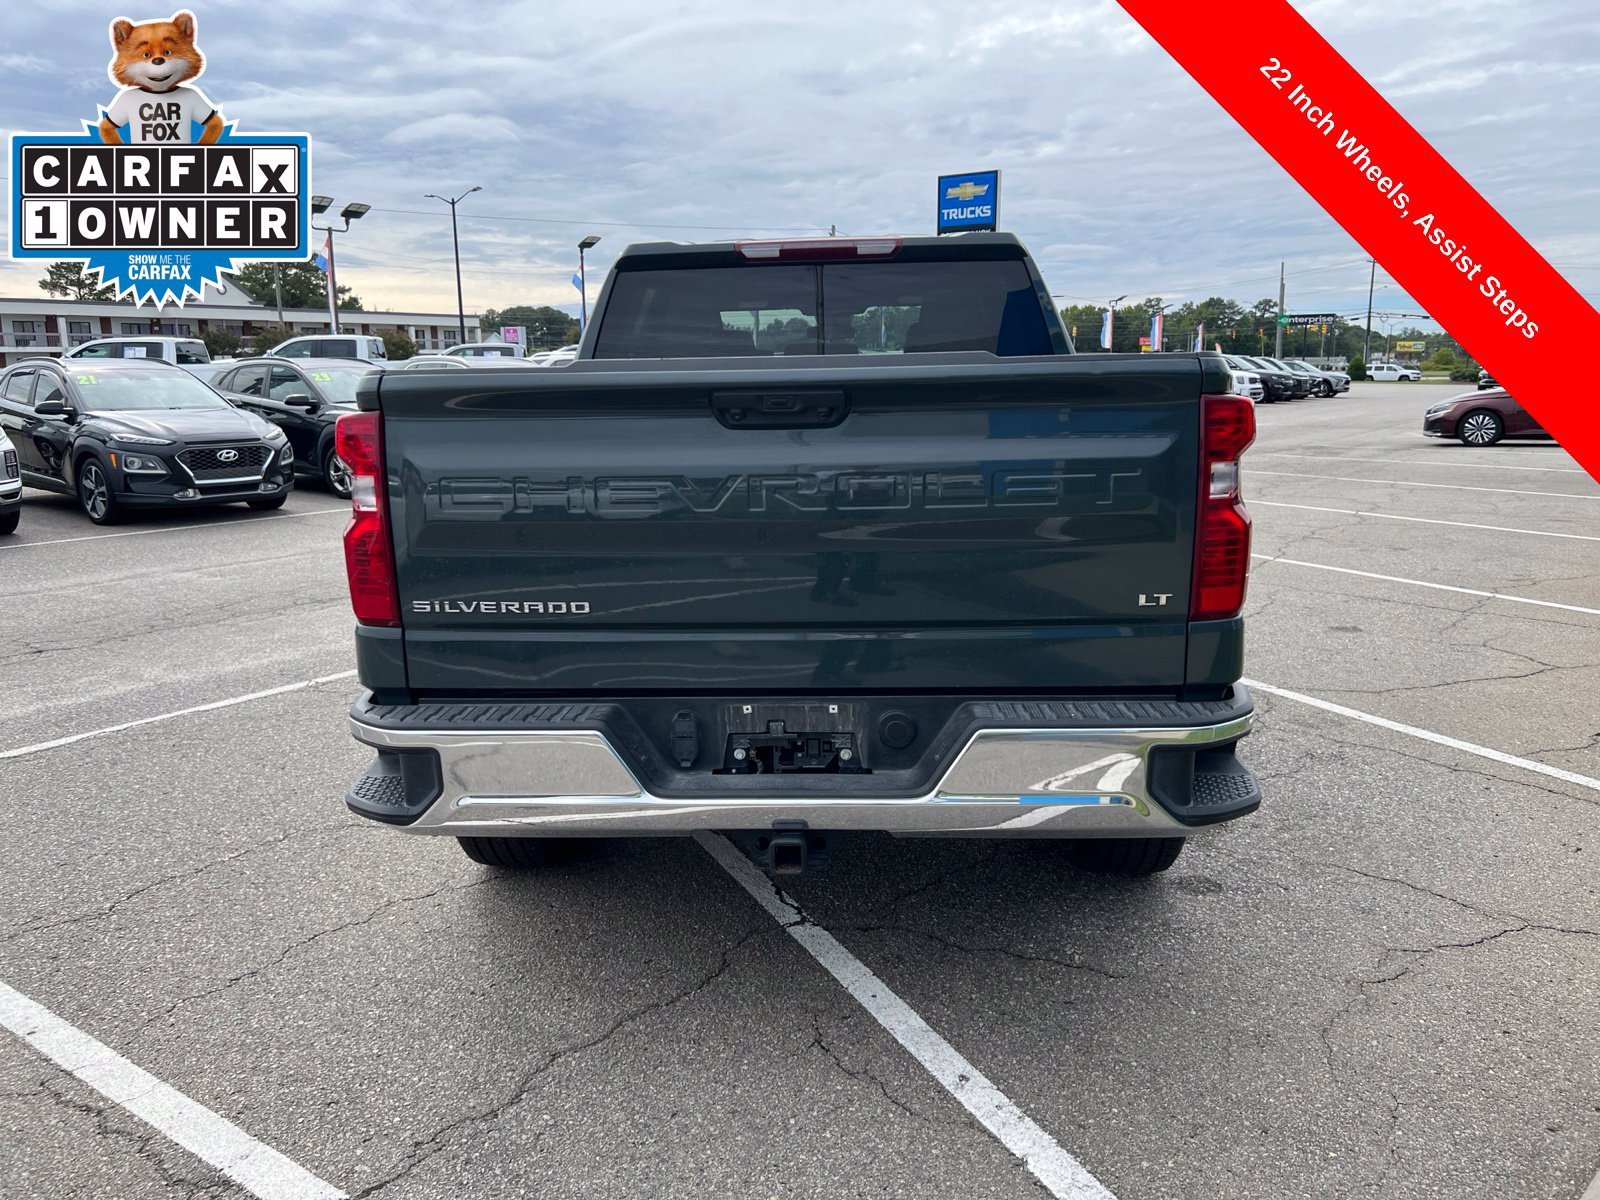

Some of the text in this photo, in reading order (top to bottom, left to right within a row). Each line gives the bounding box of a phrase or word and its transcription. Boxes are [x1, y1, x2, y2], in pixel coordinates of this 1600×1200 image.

[942, 205, 991, 220] TRUCKS
[1281, 315, 1334, 325] enterprise
[76, 375, 98, 385] 21
[311, 372, 331, 382] 23
[438, 467, 1142, 514] CHEVROLET
[412, 600, 591, 614] SILVERADO
[1138, 593, 1173, 607] LT
